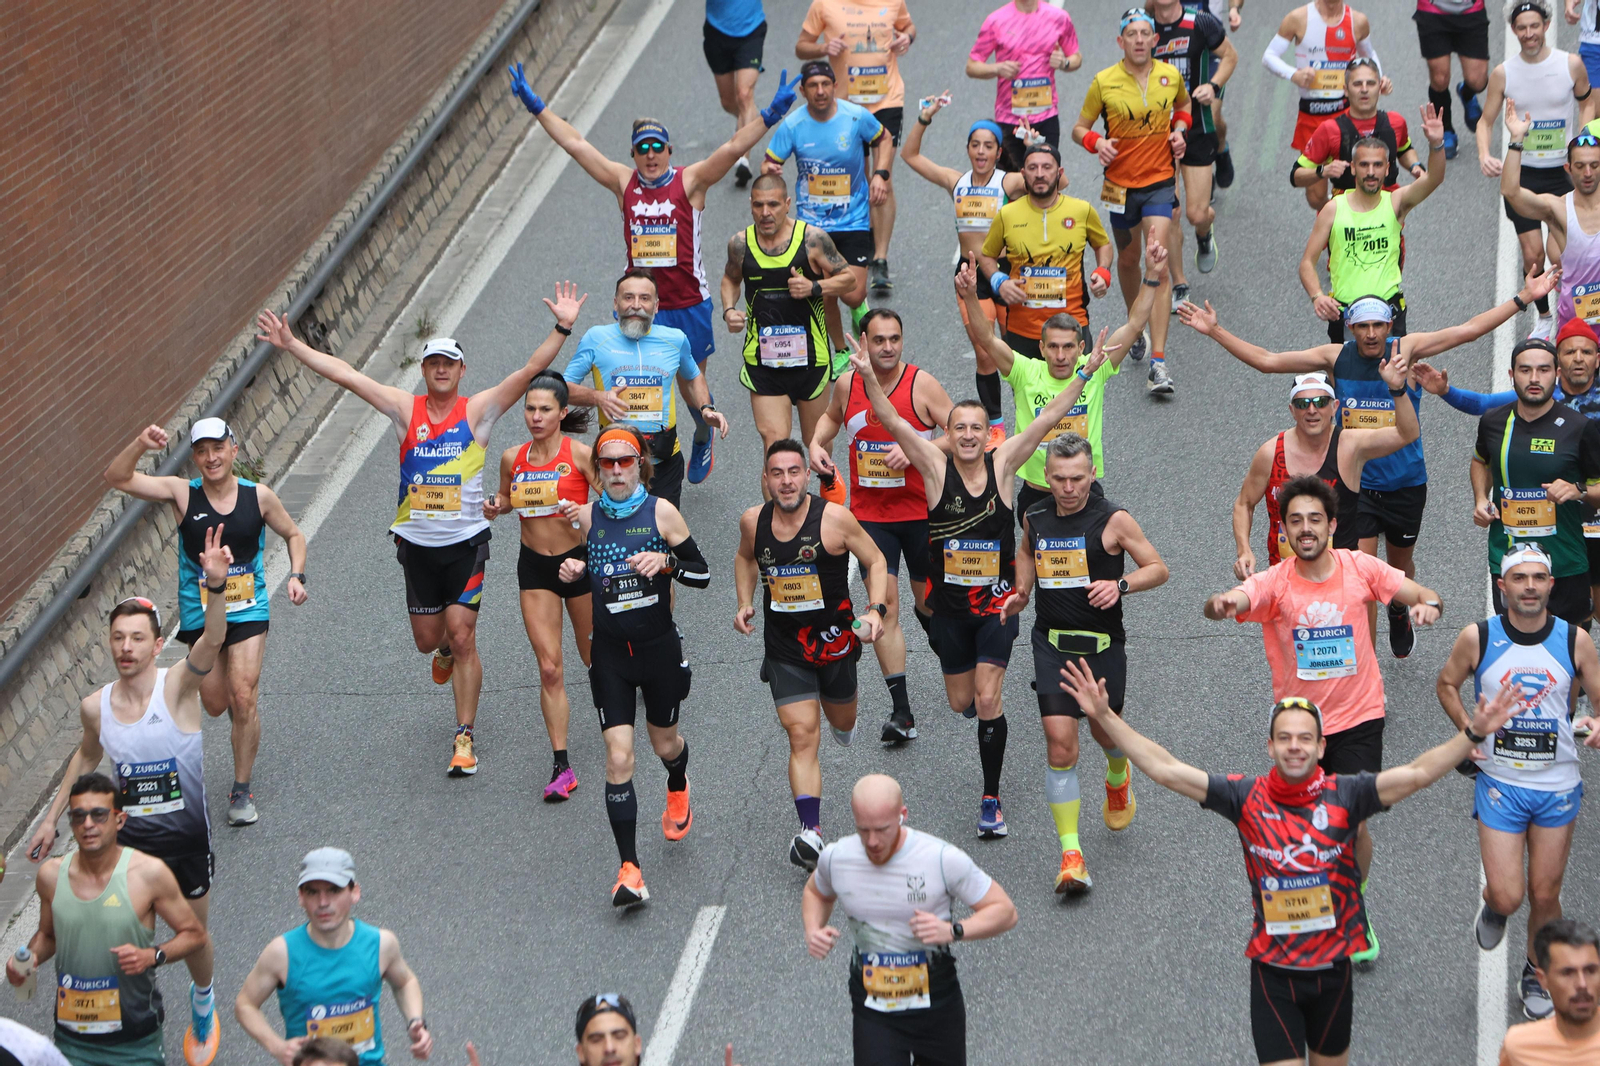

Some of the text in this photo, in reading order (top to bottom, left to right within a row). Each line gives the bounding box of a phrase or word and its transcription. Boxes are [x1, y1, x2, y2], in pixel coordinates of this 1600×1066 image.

[1323, 61, 1347, 69] ZURICH
[1024, 79, 1047, 87] ZURICH
[636, 124, 663, 134] FREEDOM
[1536, 121, 1562, 129] ZURICH
[969, 187, 994, 195] ZURICH
[645, 225, 671, 233] ZURICH
[645, 240, 661, 248] 3808
[1362, 237, 1389, 252] 2015
[1034, 268, 1061, 276] ZURICH
[1034, 282, 1049, 290] 3911
[774, 340, 791, 348] 6954
[629, 377, 657, 385] ZURICH
[1360, 400, 1390, 408] ZURICH
[1359, 415, 1378, 423] 5598
[413, 446, 462, 457] PALACIEGO
[869, 458, 884, 466] 602
[426, 476, 455, 484] ZURICH
[527, 472, 554, 480] ZURICH
[426, 491, 444, 499] 3799
[525, 487, 541, 495] 6030
[1516, 507, 1536, 515] 4676
[963, 541, 994, 550] ZURICH
[1049, 540, 1078, 548] ZURICH
[962, 557, 981, 565] 5997
[1050, 556, 1068, 565] 5647
[228, 566, 247, 575] RICH
[781, 566, 811, 575] ZURICH
[1051, 569, 1071, 577] JACEK
[618, 578, 638, 589] 3113
[783, 583, 802, 591] 4803
[618, 590, 643, 601] ANDERS
[1313, 628, 1346, 638] ZURICH
[1311, 646, 1337, 656] 12070
[1308, 659, 1344, 668] JORGERAS
[1510, 666, 1549, 675] RUNNERS
[1516, 721, 1552, 730] ZURICH
[1514, 737, 1537, 748] 3253
[135, 762, 170, 774] ZURICH
[136, 781, 159, 792] 2321
[138, 794, 164, 804] JULIAN
[1282, 877, 1320, 889] ZURICH
[1284, 897, 1308, 908] 5716
[1287, 912, 1311, 921] ISAAC
[883, 954, 918, 965] ZURICH
[74, 979, 110, 989] ZURICH
[329, 999, 366, 1015] ZURICH
